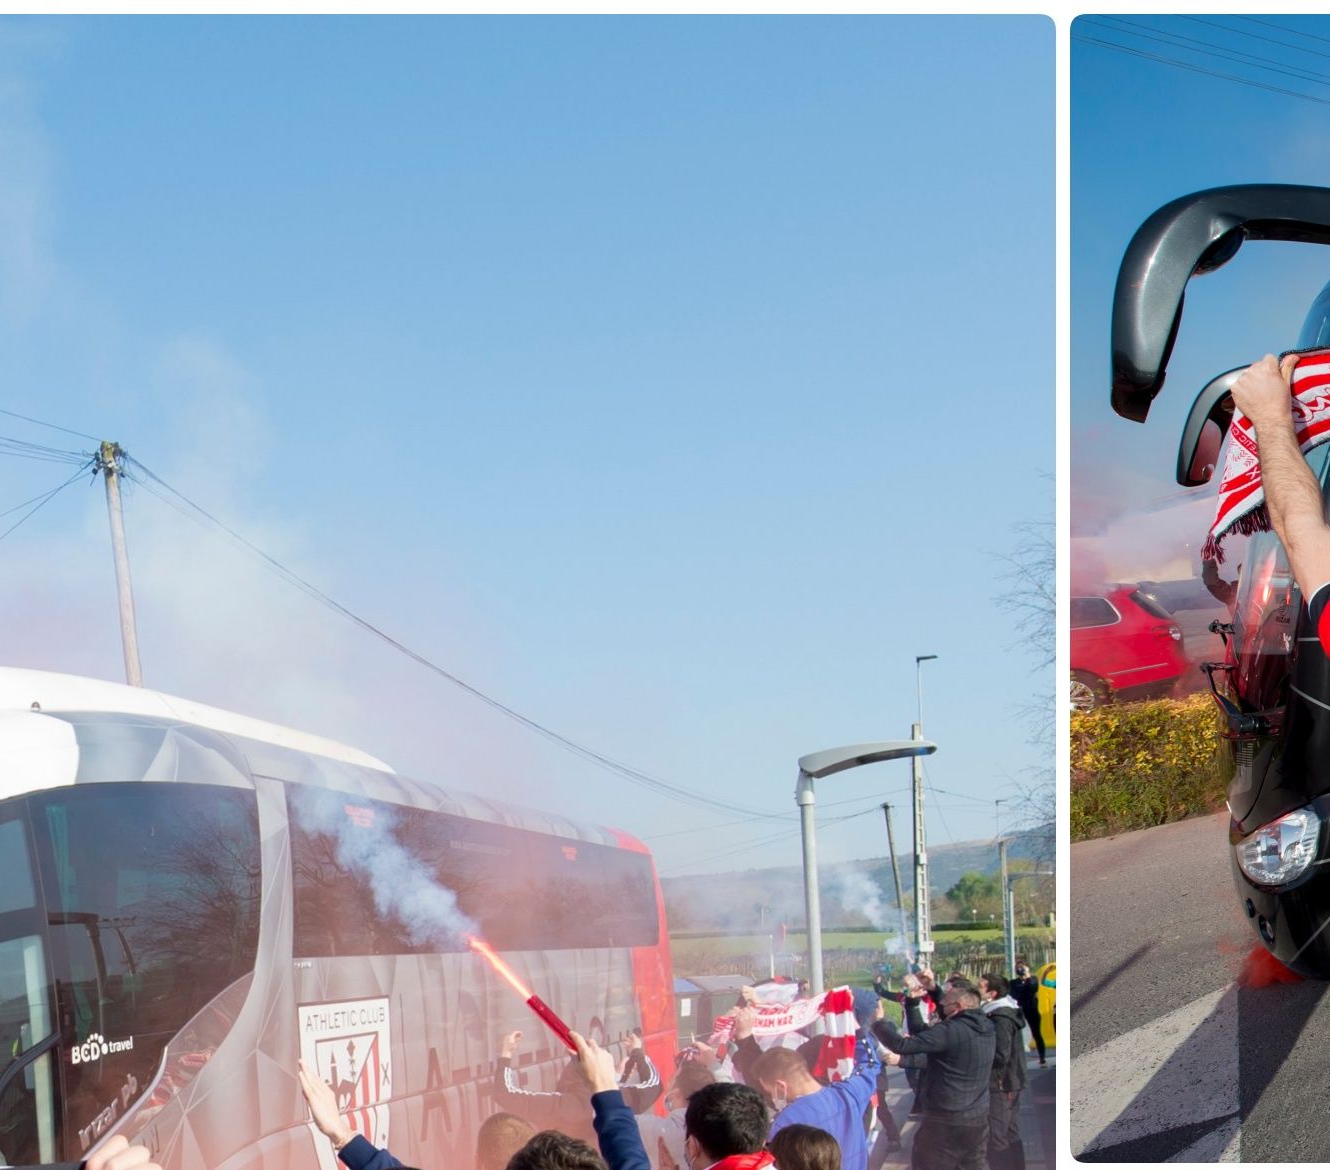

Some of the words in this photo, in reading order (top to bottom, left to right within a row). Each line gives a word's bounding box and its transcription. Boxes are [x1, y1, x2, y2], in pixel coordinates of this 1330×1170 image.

[305, 1009, 357, 1033] ATHLETIC
[360, 1006, 386, 1026] CLUB
[71, 1042, 101, 1064] BCD
[109, 1036, 134, 1053] travel
